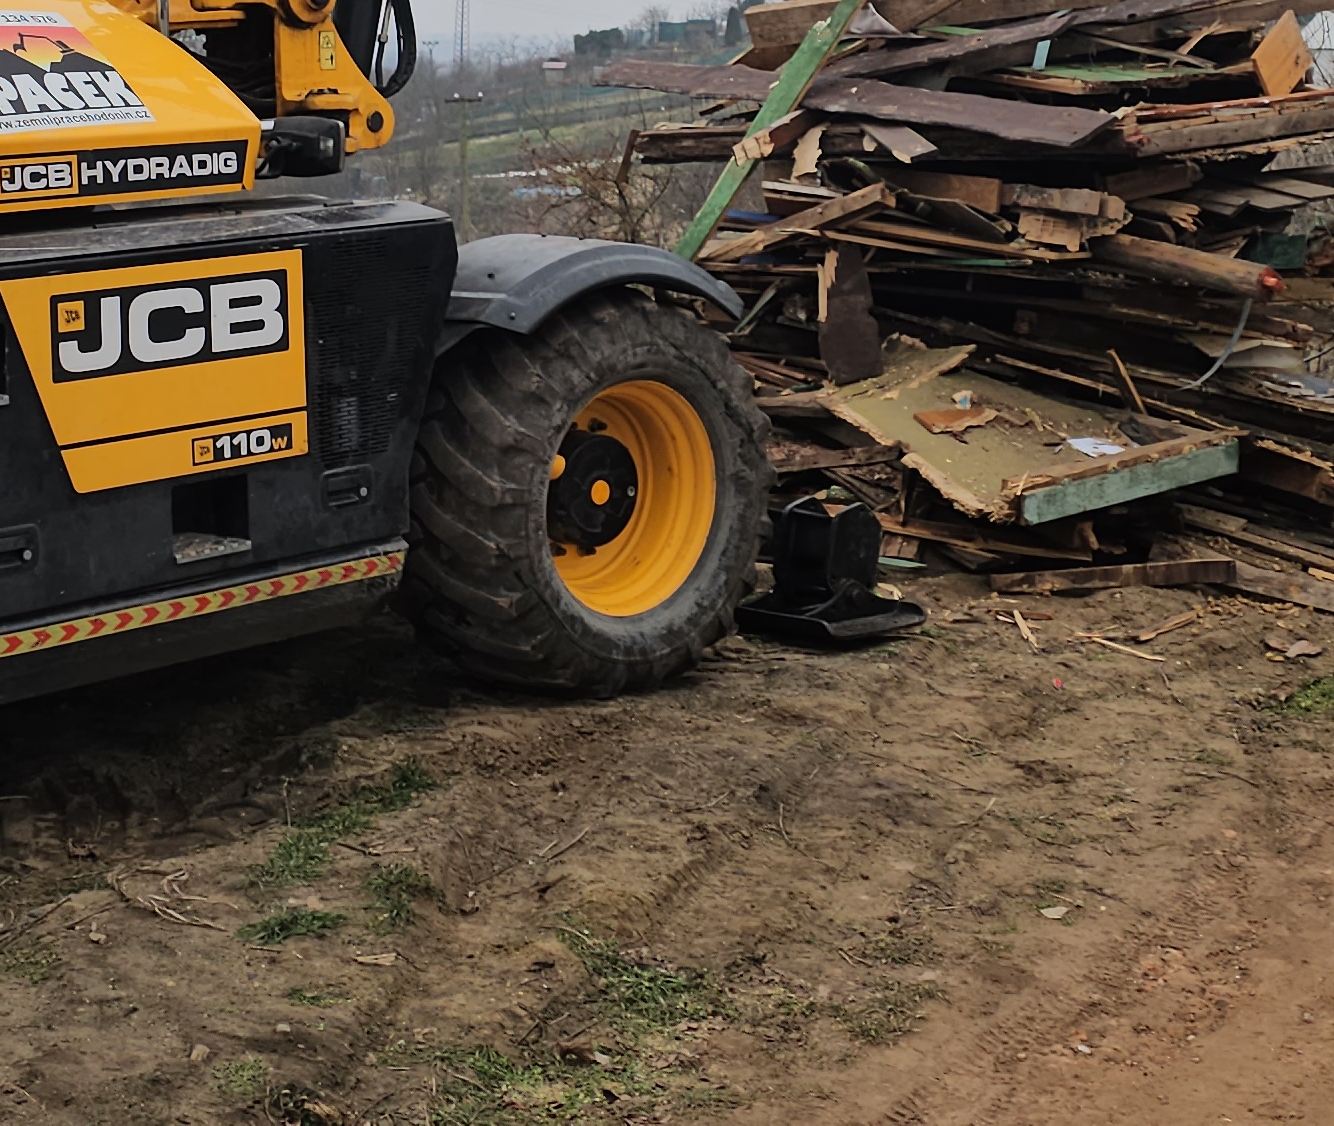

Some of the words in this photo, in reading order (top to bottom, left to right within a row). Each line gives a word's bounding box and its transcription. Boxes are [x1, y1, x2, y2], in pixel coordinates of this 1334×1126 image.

[1, 14, 29, 23] 134
[1, 163, 72, 191] JCB
[81, 151, 238, 185] HYDRADIG
[58, 278, 284, 373] JCB
